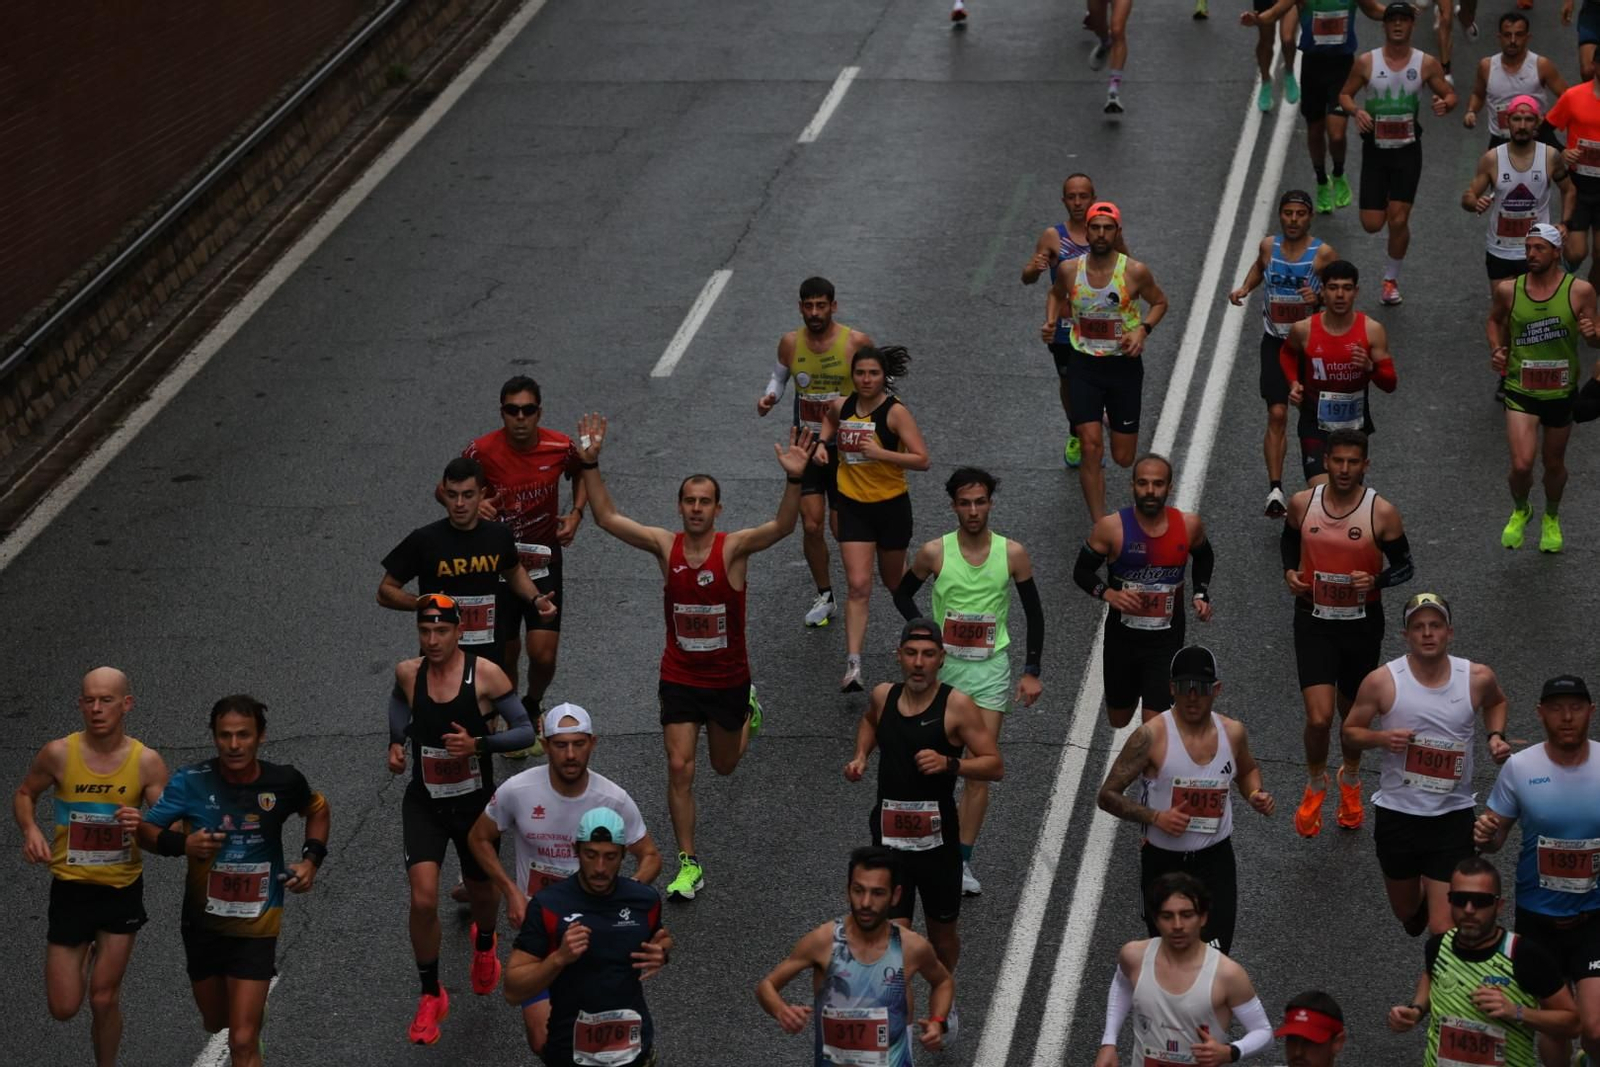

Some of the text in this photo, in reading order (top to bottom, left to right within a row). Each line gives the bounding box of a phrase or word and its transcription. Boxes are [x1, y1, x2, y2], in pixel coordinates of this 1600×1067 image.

[840, 431, 860, 446] 947
[436, 553, 501, 578] ARMY
[1322, 582, 1353, 600] 1367
[684, 616, 710, 631] 364
[952, 625, 983, 639] 1250
[1416, 749, 1452, 770] 1301
[75, 784, 127, 795] WEST 4
[1528, 776, 1551, 786] HOKA
[83, 827, 112, 843] 715
[1548, 852, 1588, 870] 1397
[222, 876, 251, 893] 961
[586, 1024, 625, 1044] 1076
[835, 1023, 866, 1040] 317
